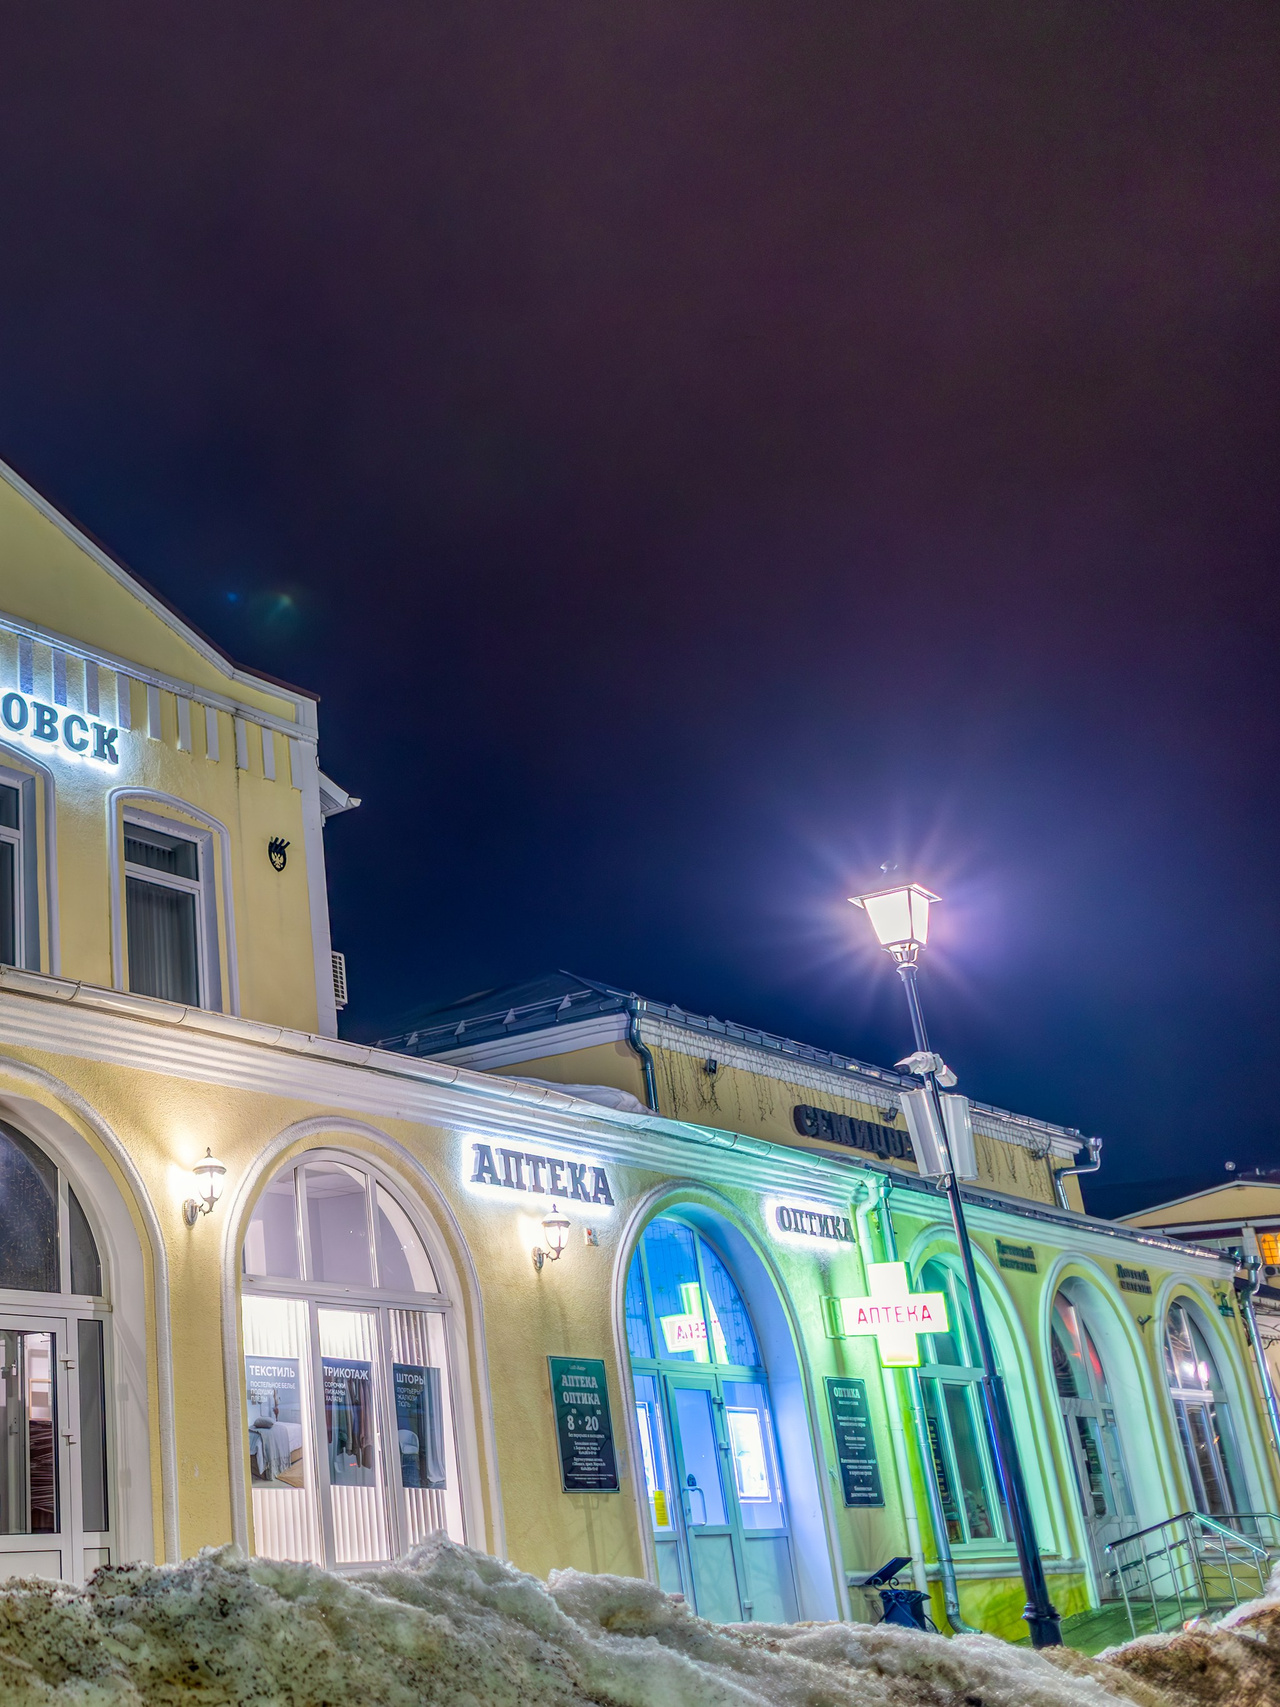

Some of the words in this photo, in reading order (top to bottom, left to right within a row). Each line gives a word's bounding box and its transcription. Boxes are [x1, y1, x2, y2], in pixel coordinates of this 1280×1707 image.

[470, 1143, 615, 1207] АПТЕКА
[776, 1205, 856, 1244] ОПТИКА
[858, 1305, 933, 1325] АПТЕКА
[249, 1365, 296, 1378] ТЕКСТИЛЬ
[323, 1366, 369, 1380] ТРИКОТАЖ
[396, 1373, 426, 1385] ШТОРЫ
[561, 1374, 599, 1389] АПТЕКА
[562, 1391, 601, 1405] ОПТИКА
[833, 1386, 861, 1399] ОПТИКА
[566, 1415, 575, 1431] 8
[585, 1415, 599, 1431] 20
